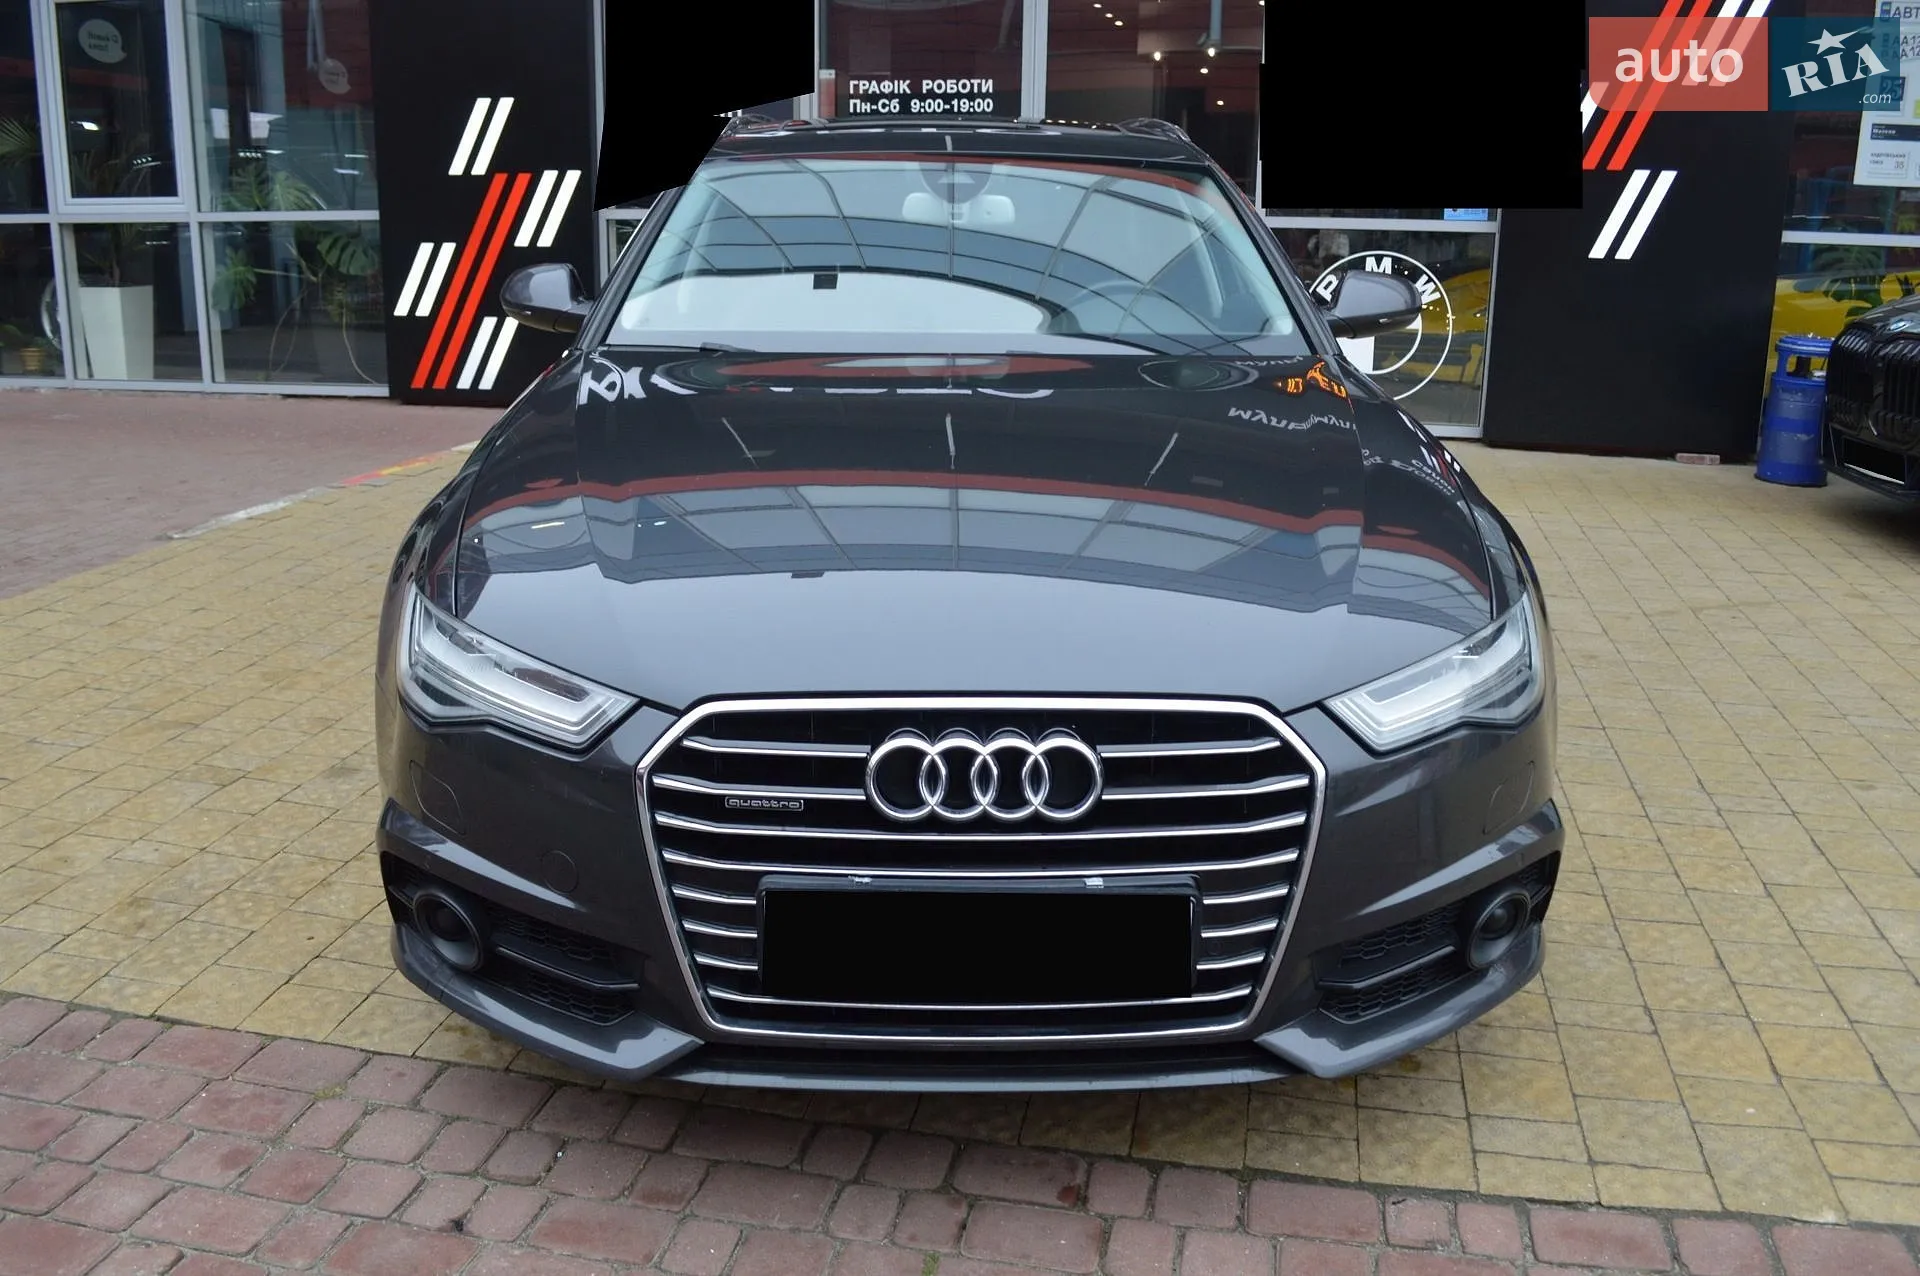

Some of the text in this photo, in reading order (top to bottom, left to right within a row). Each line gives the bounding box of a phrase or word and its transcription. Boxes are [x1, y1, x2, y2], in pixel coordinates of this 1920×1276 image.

[849, 79, 993, 94] ГРАФІК РОБОТИ
[849, 98, 994, 113] Пн-Сб 9:00-19:00
[728, 799, 800, 809] quattro
